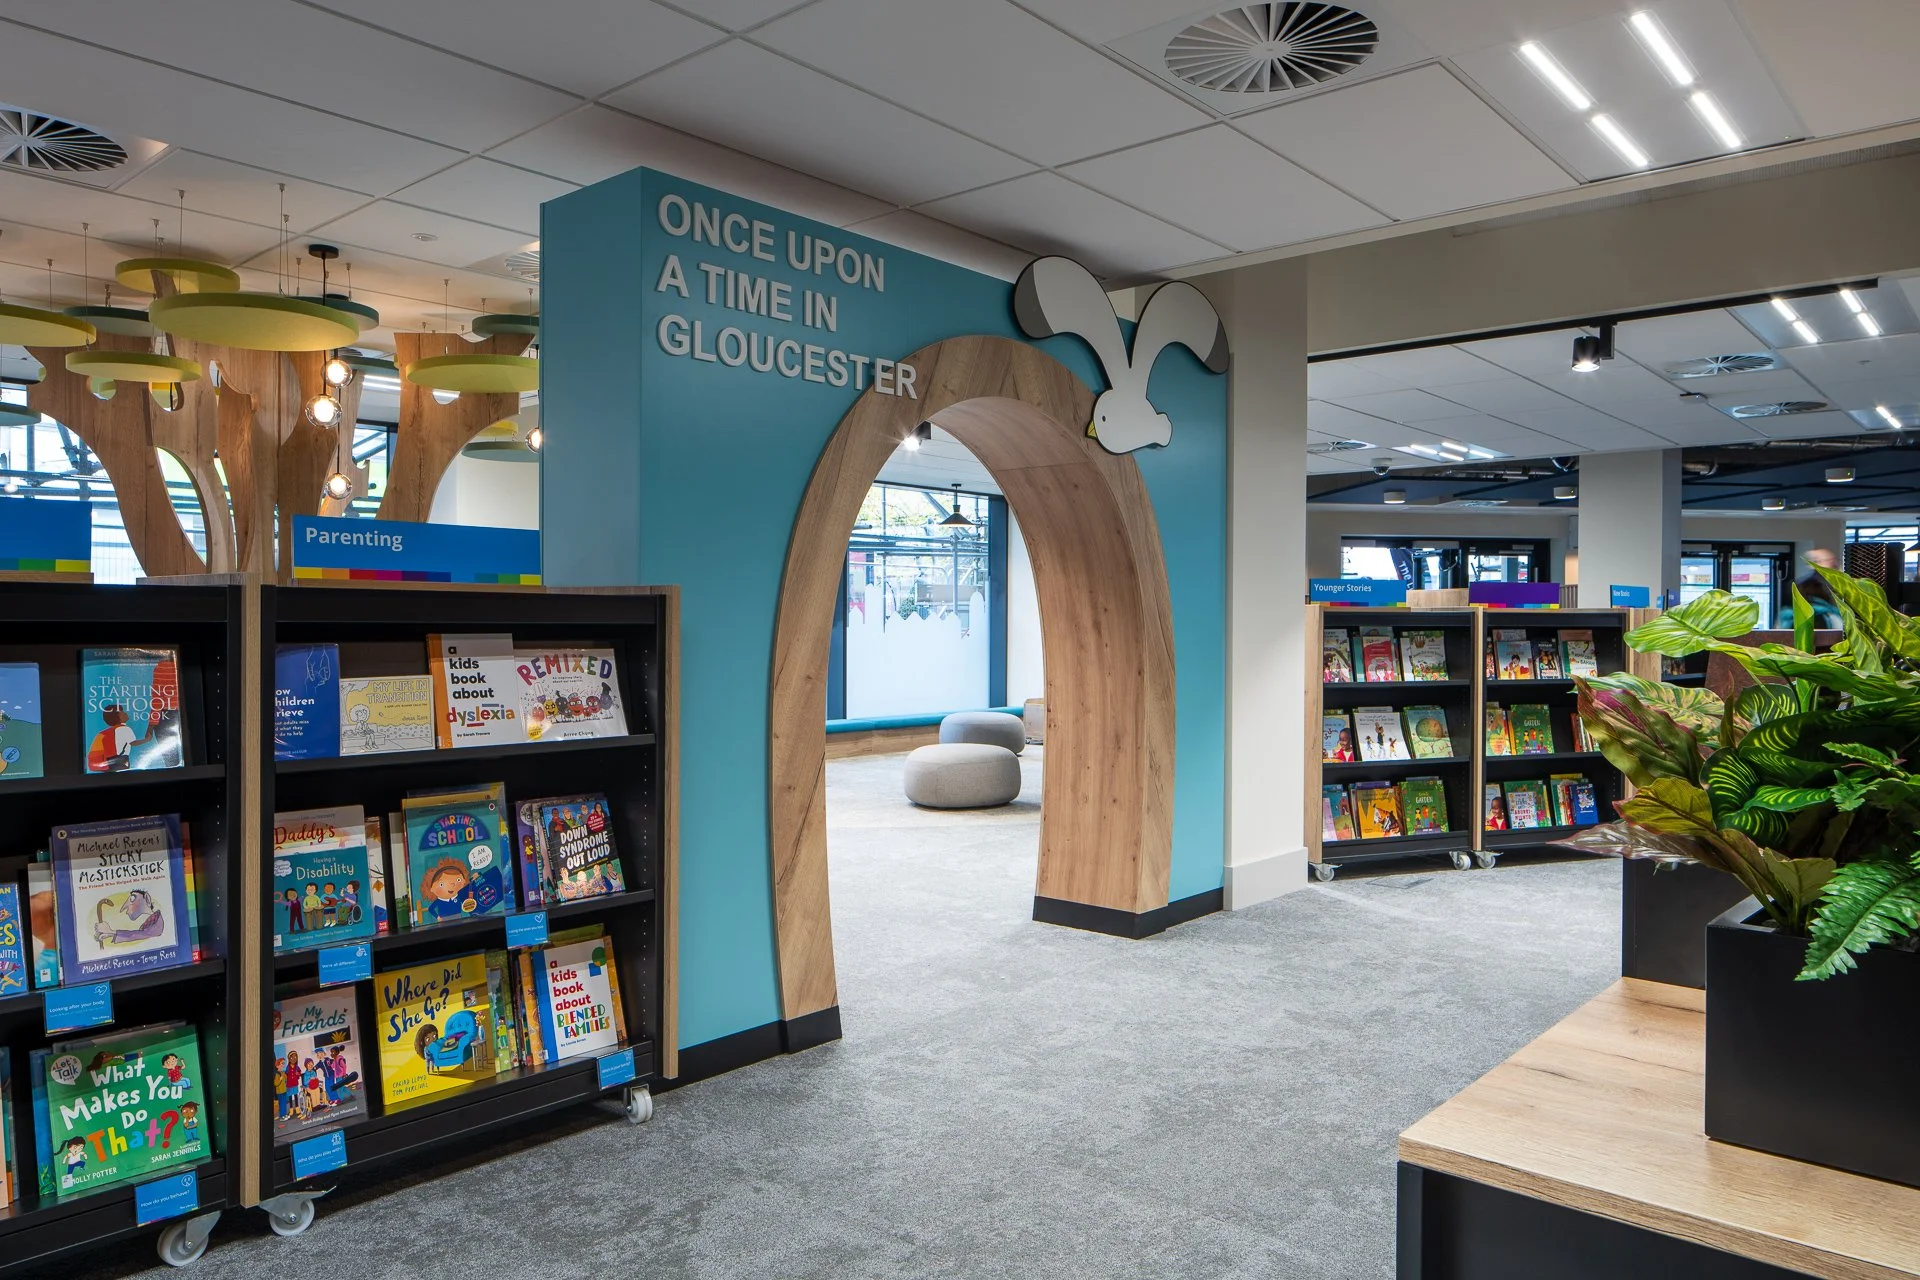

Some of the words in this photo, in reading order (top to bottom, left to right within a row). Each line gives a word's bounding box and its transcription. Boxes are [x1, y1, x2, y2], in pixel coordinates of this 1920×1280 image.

[657, 194, 776, 262] ONCE
[787, 229, 885, 292] UPON
[656, 254, 690, 298] A
[700, 262, 793, 322] TIME
[803, 289, 838, 332] IN
[656, 313, 918, 400] GLOUCESTER
[305, 527, 403, 551] Parenting
[1313, 583, 1345, 593] Younger
[1346, 583, 1372, 592] Stories
[447, 646, 457, 654] a
[449, 658, 479, 669] kids
[516, 653, 613, 686] REMIXED
[100, 676, 123, 685] THE
[372, 681, 391, 692] MY
[393, 680, 414, 691] LIFE
[416, 680, 427, 690] IN
[451, 672, 486, 684] book
[89, 684, 175, 698] STARTING
[366, 691, 428, 704] TRANSITION
[452, 687, 494, 699] about
[88, 697, 177, 713] SCHOOL
[275, 696, 315, 706] hildren
[133, 711, 170, 721] BOOK
[276, 709, 304, 717] rieve
[446, 704, 516, 727] dyslexia
[434, 815, 475, 830] STARTING
[274, 823, 336, 845] Daddy's
[428, 826, 484, 847] SCHOOL
[560, 825, 588, 844] DOWN
[77, 838, 119, 852] Michael
[123, 834, 160, 849] Rosen's
[560, 831, 609, 858] SYNDROME
[99, 849, 143, 867] STICKY
[473, 854, 491, 867] READY!
[477, 848, 486, 856] AM
[566, 852, 585, 869] OUT
[587, 844, 610, 862] LOUD
[79, 860, 164, 883] McSTICKSTICK
[296, 863, 355, 880] Disability
[82, 962, 111, 974] Michael
[113, 959, 134, 969] Rosen
[140, 954, 158, 964] Tony
[160, 951, 176, 960] Ross
[550, 960, 558, 968] a
[551, 969, 577, 983] kids
[384, 975, 439, 1009] Where
[443, 962, 462, 986] Did
[553, 982, 584, 997] book
[555, 994, 591, 1011] about
[304, 1005, 322, 1019] My
[387, 1007, 422, 1043] She
[424, 987, 450, 1020] Go?
[557, 1004, 606, 1028] BLENDED
[282, 1010, 346, 1038] Friends
[564, 1015, 610, 1039] FAMILIES
[55, 1057, 78, 1069] Let's
[55, 1066, 79, 1079] Talk
[90, 1057, 145, 1087] What
[412, 1075, 426, 1083] LLOYD
[59, 1088, 141, 1131] Makes
[146, 1074, 183, 1101] You
[121, 1109, 148, 1130] Do
[86, 1110, 180, 1162] That?
[151, 1152, 171, 1164] SARAH
[172, 1144, 201, 1157] JENNINGS
[92, 1167, 117, 1179] POTTER
[141, 1200, 152, 1208] How
[160, 1196, 169, 1204] you
[170, 1190, 190, 1200] behave?
